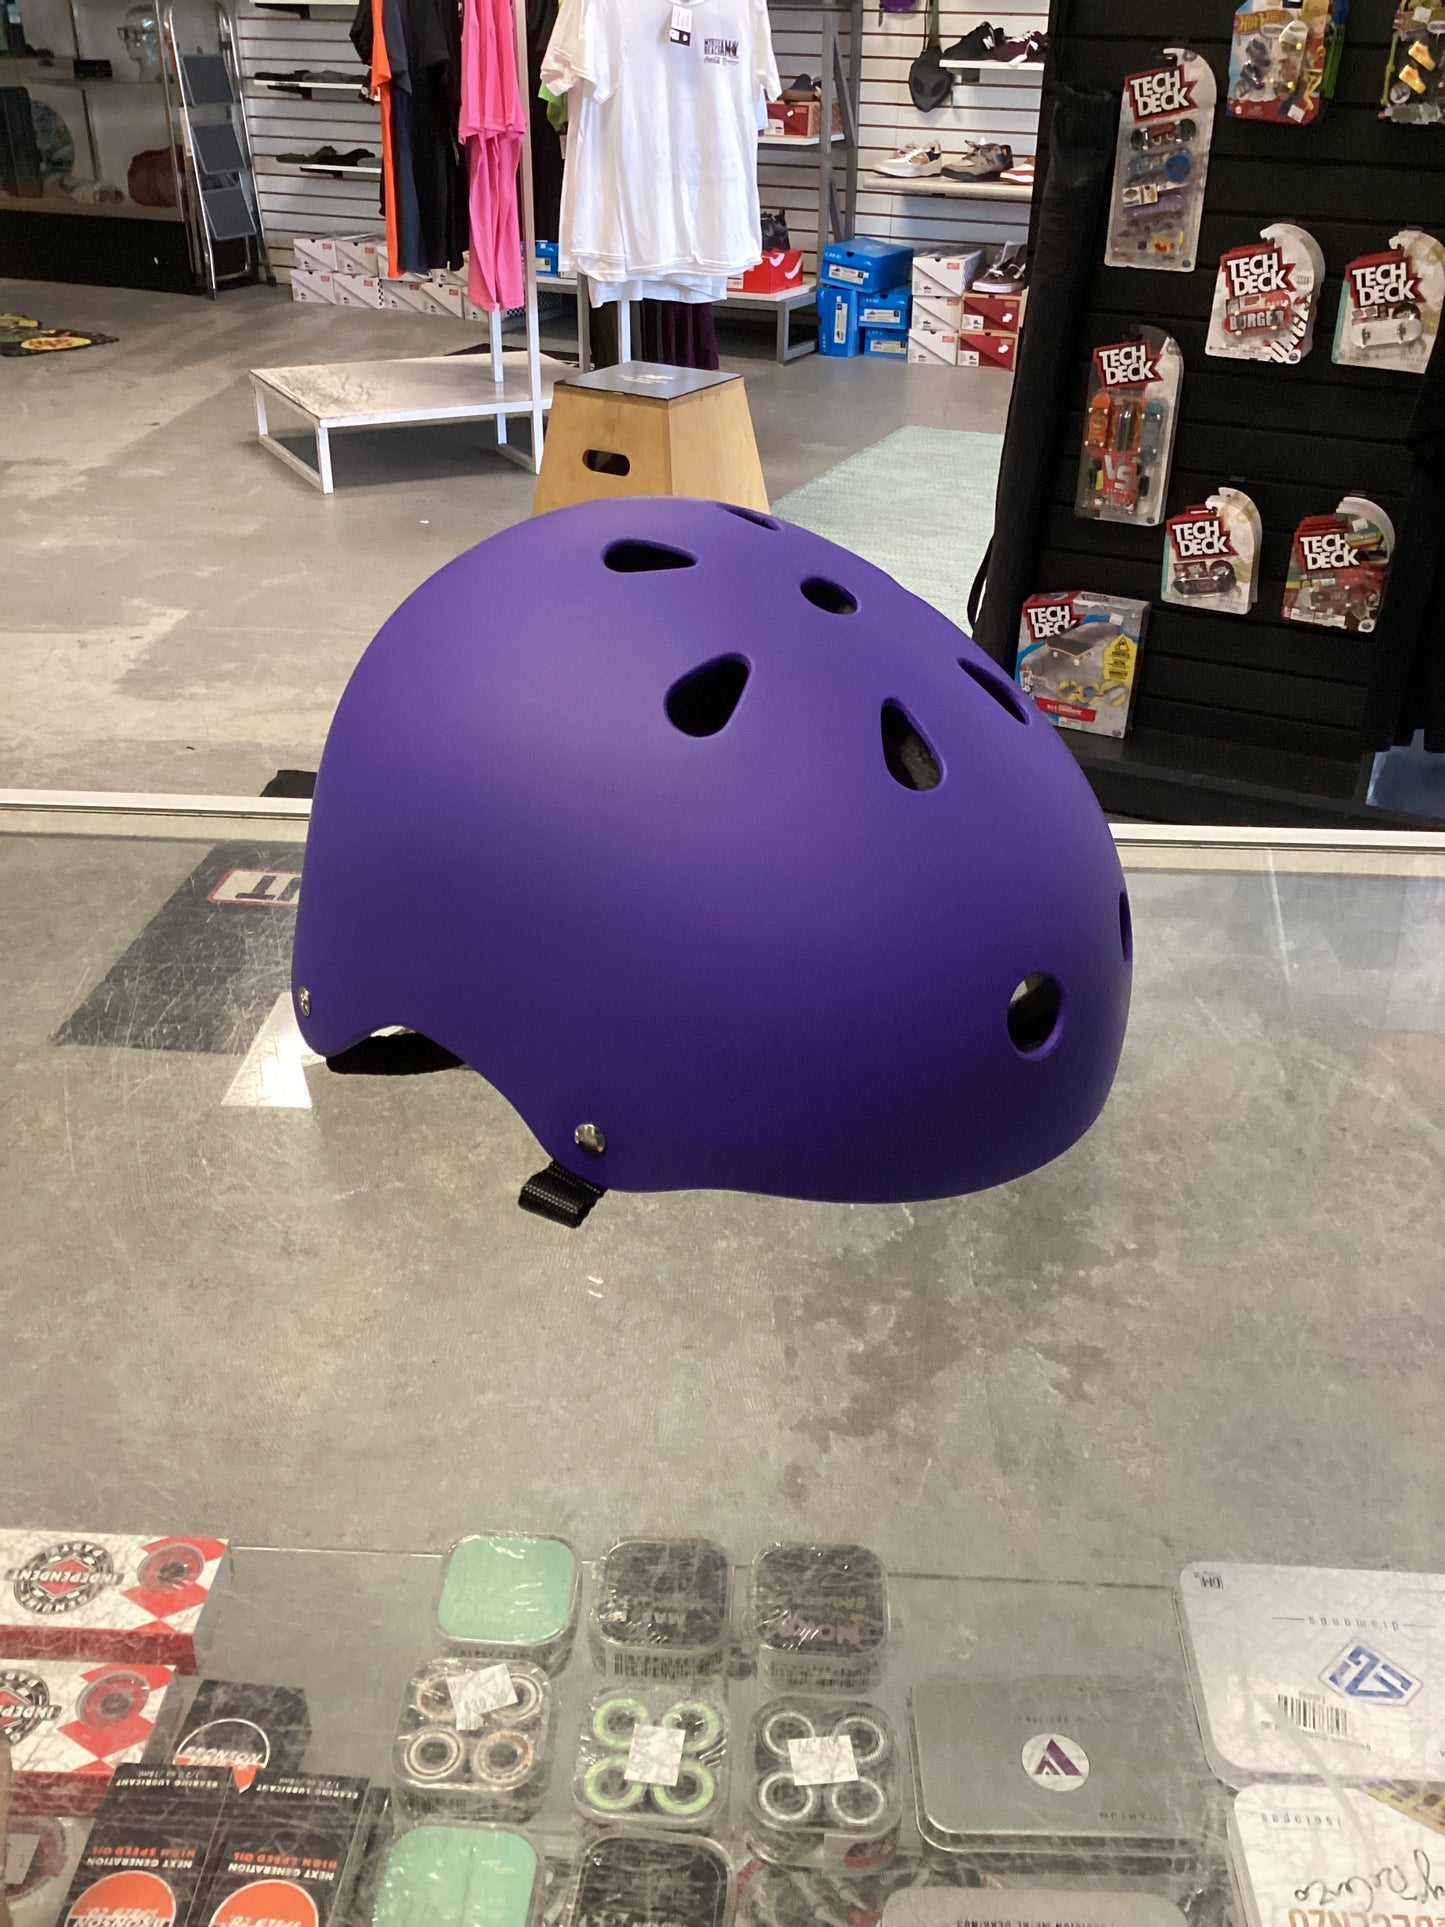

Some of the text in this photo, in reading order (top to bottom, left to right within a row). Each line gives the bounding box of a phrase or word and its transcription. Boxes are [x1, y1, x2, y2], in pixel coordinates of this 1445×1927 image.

[1130, 70, 1181, 96] TECH
[1136, 87, 1190, 116] DECK
[1227, 253, 1278, 278] TECH
[1352, 264, 1406, 291] TECH
[1232, 268, 1287, 297] DECK
[1360, 278, 1416, 306] DECK
[1230, 310, 1285, 330] BURGER
[1099, 345, 1147, 372] TECH
[1105, 357, 1156, 385] DECK
[1104, 454, 1133, 490] VS
[1172, 521, 1222, 547] TECH
[1178, 533, 1230, 557] DECK
[1300, 534, 1349, 556] TECH
[1306, 547, 1360, 570] DECK
[1027, 605, 1070, 625] TECH
[13, 1569, 119, 1584] INDEPENDENT
[115, 1778, 170, 1787] LUBRICANT
[86, 1856, 192, 1868] NEXT GENERATION
[92, 1845, 196, 1857] HIGH SPEED OIL
[233, 1851, 338, 1869] HIGH SPEED OIL
[227, 1862, 334, 1881] NEXT GENERATION
